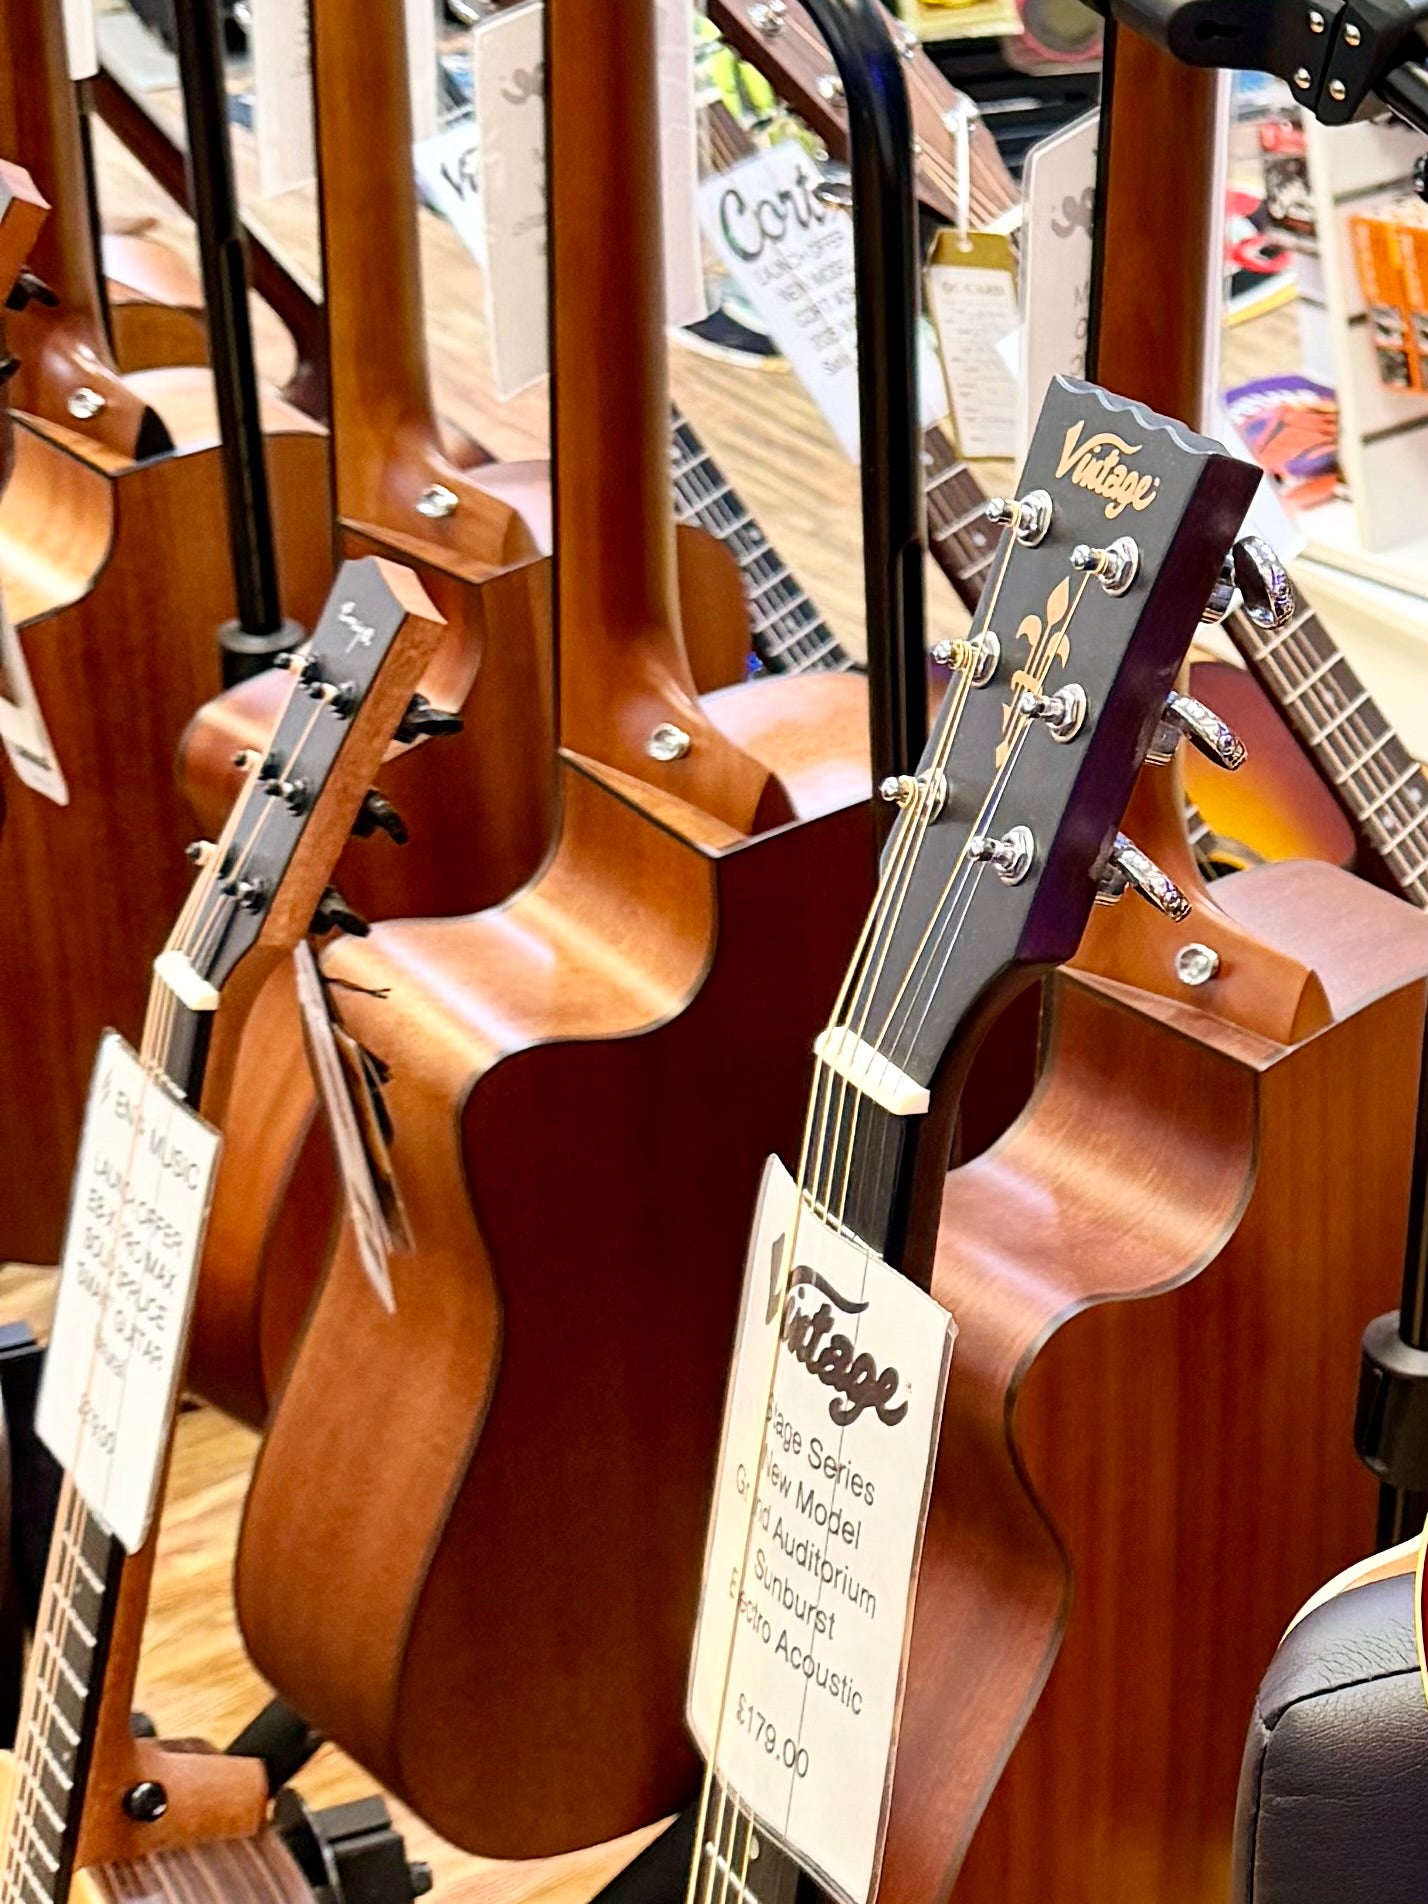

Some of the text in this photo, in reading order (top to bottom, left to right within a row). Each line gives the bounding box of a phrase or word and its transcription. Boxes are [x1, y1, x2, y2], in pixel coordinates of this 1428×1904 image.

[720, 163, 827, 263] Cort
[1055, 419, 1157, 520] Vintage
[765, 1232, 909, 1427] Vintage
[762, 1448, 862, 1551] New Model
[807, 1437, 875, 1507] Series
[736, 1462, 877, 1620] Grnd Auditorium
[729, 1565, 864, 1717] Eectro Acoustic
[754, 1547, 836, 1641] Sunburst
[735, 1691, 811, 1780] £179.00
